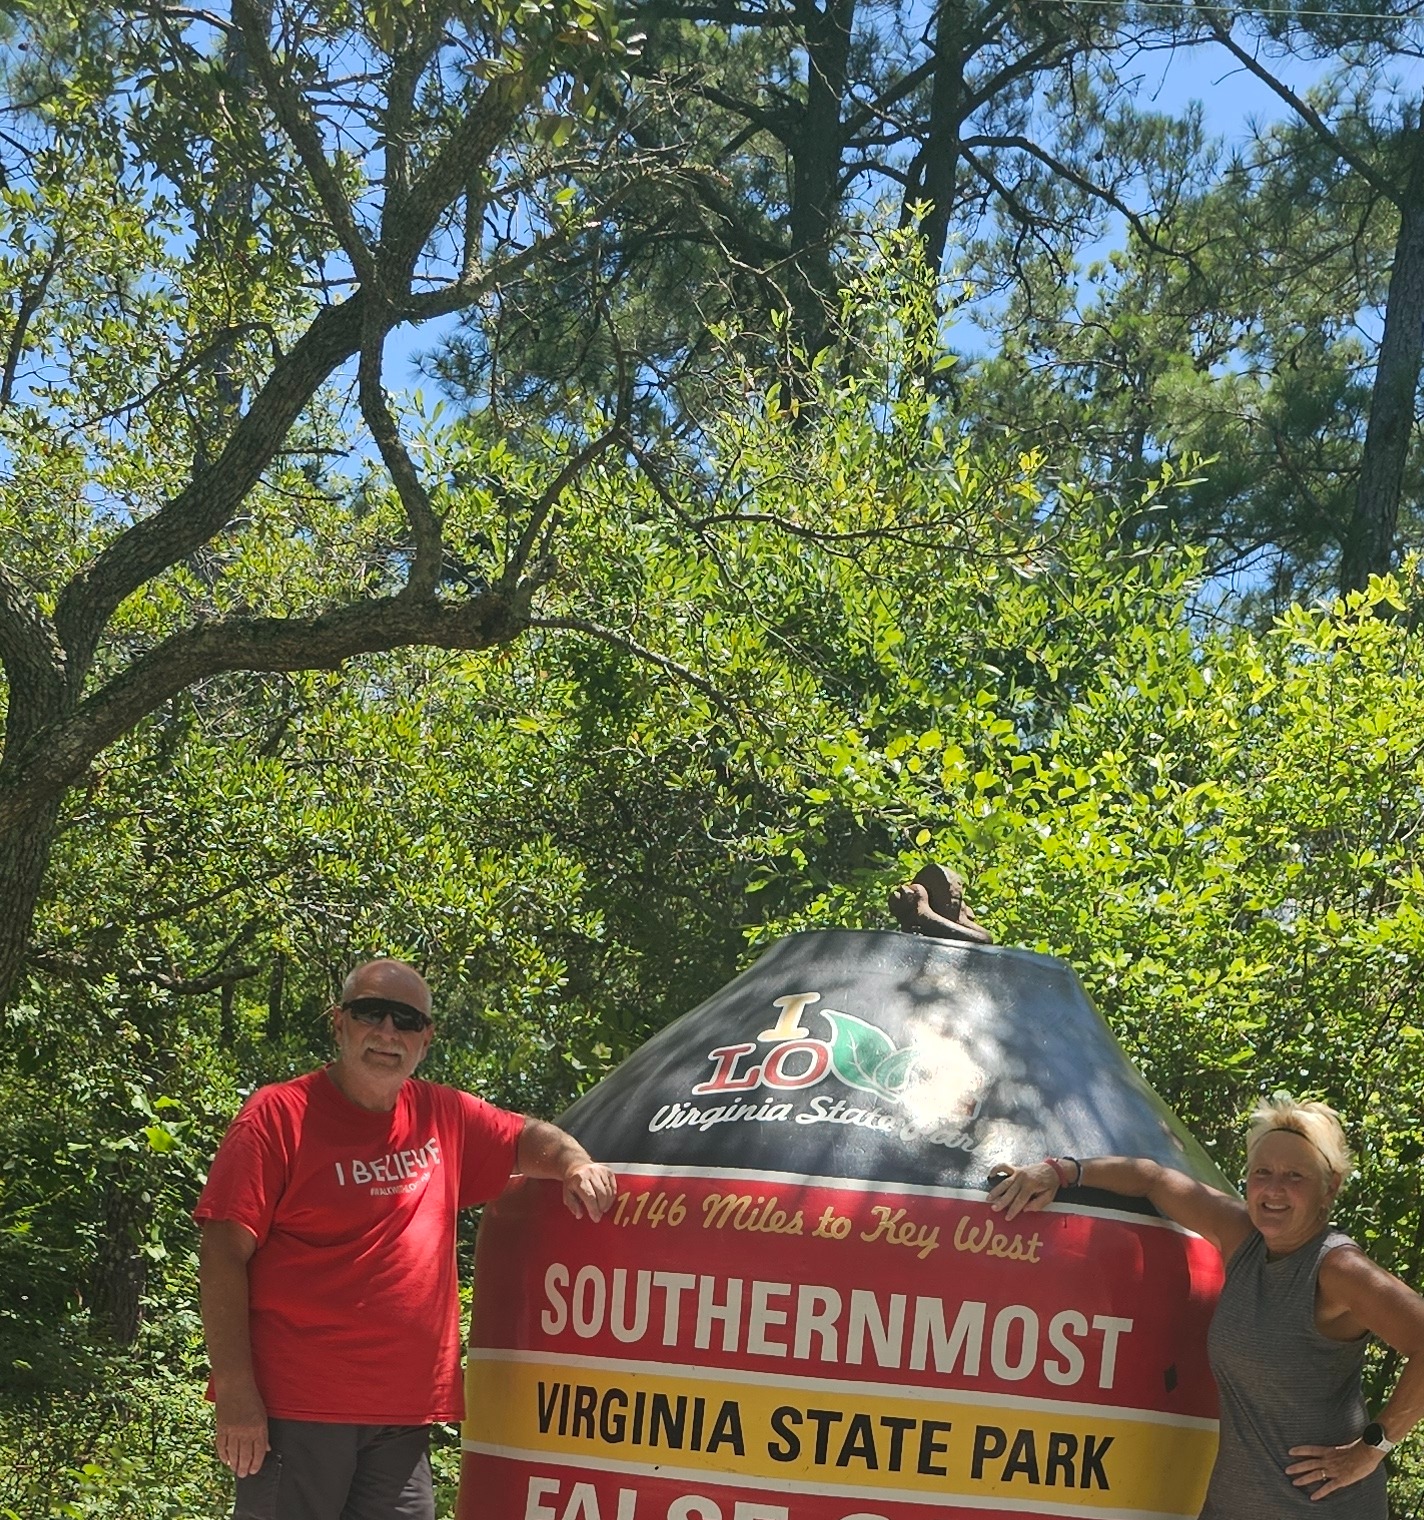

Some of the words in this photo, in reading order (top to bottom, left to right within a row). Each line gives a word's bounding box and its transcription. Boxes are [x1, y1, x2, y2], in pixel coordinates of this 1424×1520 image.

[757, 992, 820, 1041] I
[649, 1098, 791, 1132] Virginia
[335, 1163, 345, 1186] I
[352, 1137, 441, 1184] BELIEVE
[613, 1191, 687, 1228] 1,146
[702, 1193, 804, 1235] Miles
[811, 1206, 851, 1239] to
[860, 1205, 939, 1260] Key
[954, 1216, 1044, 1264] West
[541, 1263, 1134, 1389] SOUTHERNMOST
[536, 1381, 746, 1458] VIRGINIA
[767, 1405, 950, 1476] STATE
[970, 1425, 1116, 1490] PARK
